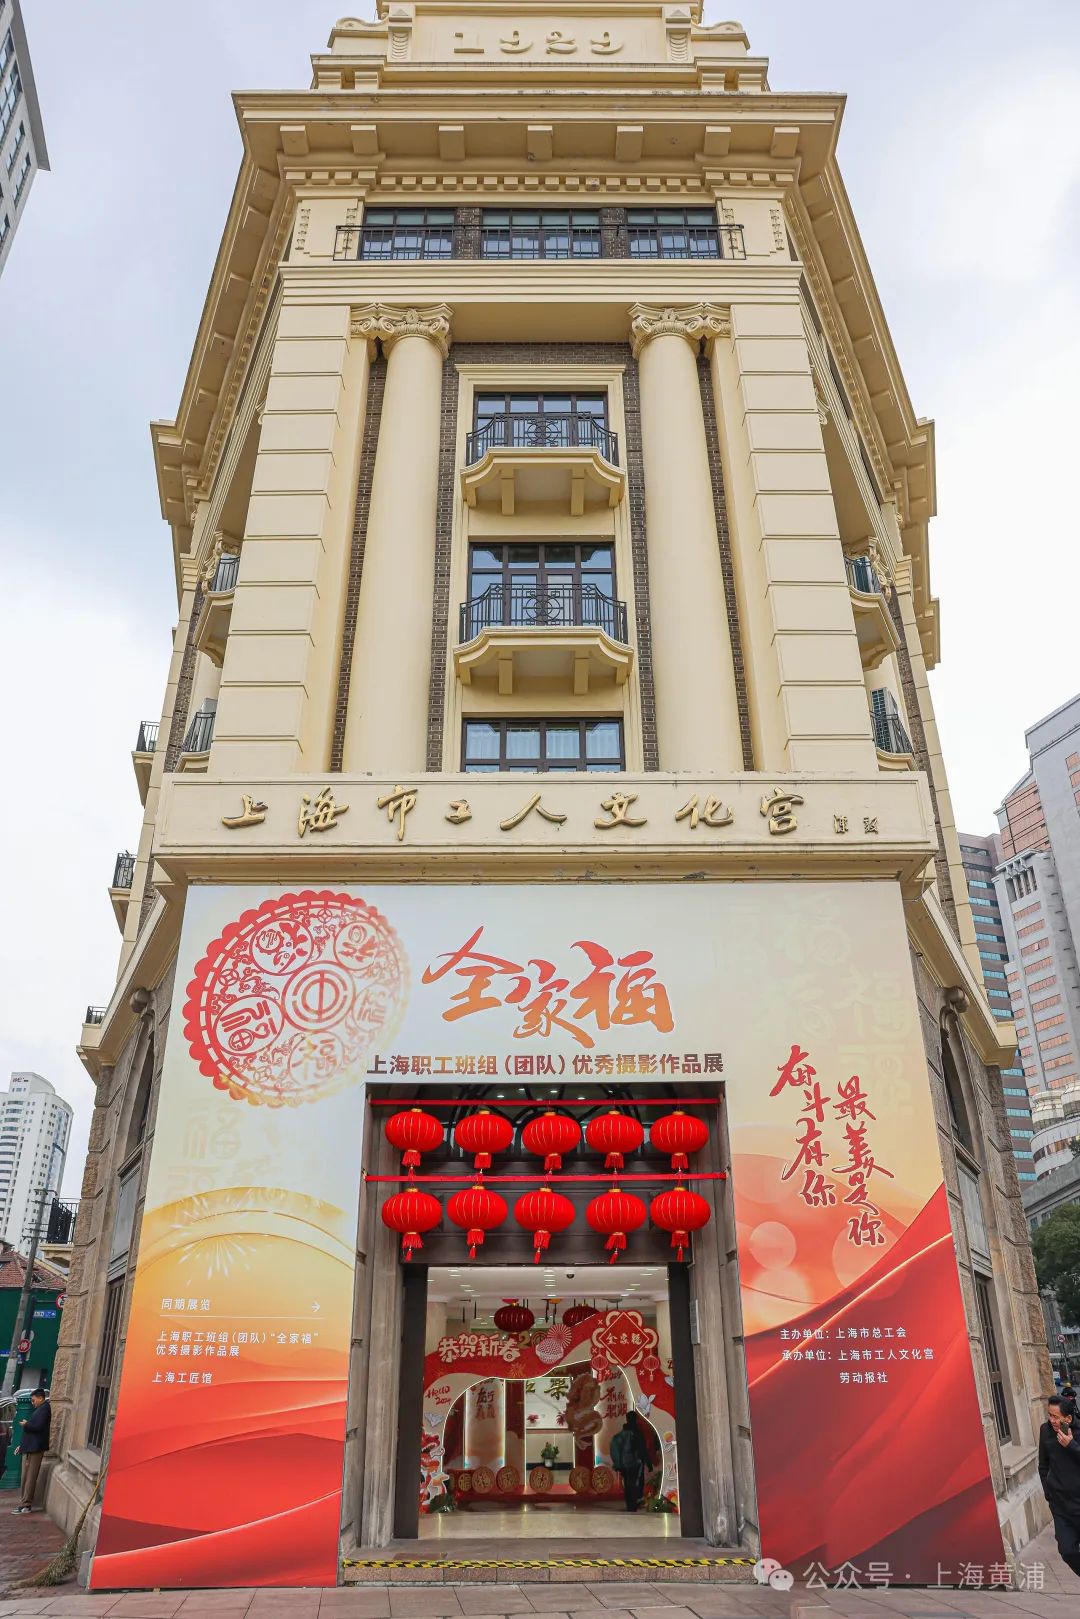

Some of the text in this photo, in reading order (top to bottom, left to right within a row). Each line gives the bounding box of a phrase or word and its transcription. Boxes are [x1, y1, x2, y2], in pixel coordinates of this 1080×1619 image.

[453, 31, 623, 54] 1929
[222, 785, 804, 842] 上海市工人文化宫
[421, 926, 675, 1049] 全家福
[366, 1053, 724, 1076] 上海职工班组（团队）优秀摄影作品展
[768, 1044, 837, 1207] 奋斗有你
[831, 1075, 895, 1246] 最美是你
[161, 1298, 211, 1311] 同期展览
[156, 1331, 319, 1345] 上海职工班组（团队）“全家福”
[780, 1327, 907, 1340] 主办单位：上海市总工会
[156, 1344, 240, 1357] 优秀摄影作品展
[439, 1333, 521, 1363] 恭贺新春
[782, 1348, 935, 1361] 承办单位：上海市工人文化宫
[151, 1372, 213, 1384] 上海工匠馆
[839, 1371, 889, 1384] 劳动报社
[425, 1385, 451, 1399] Hello
